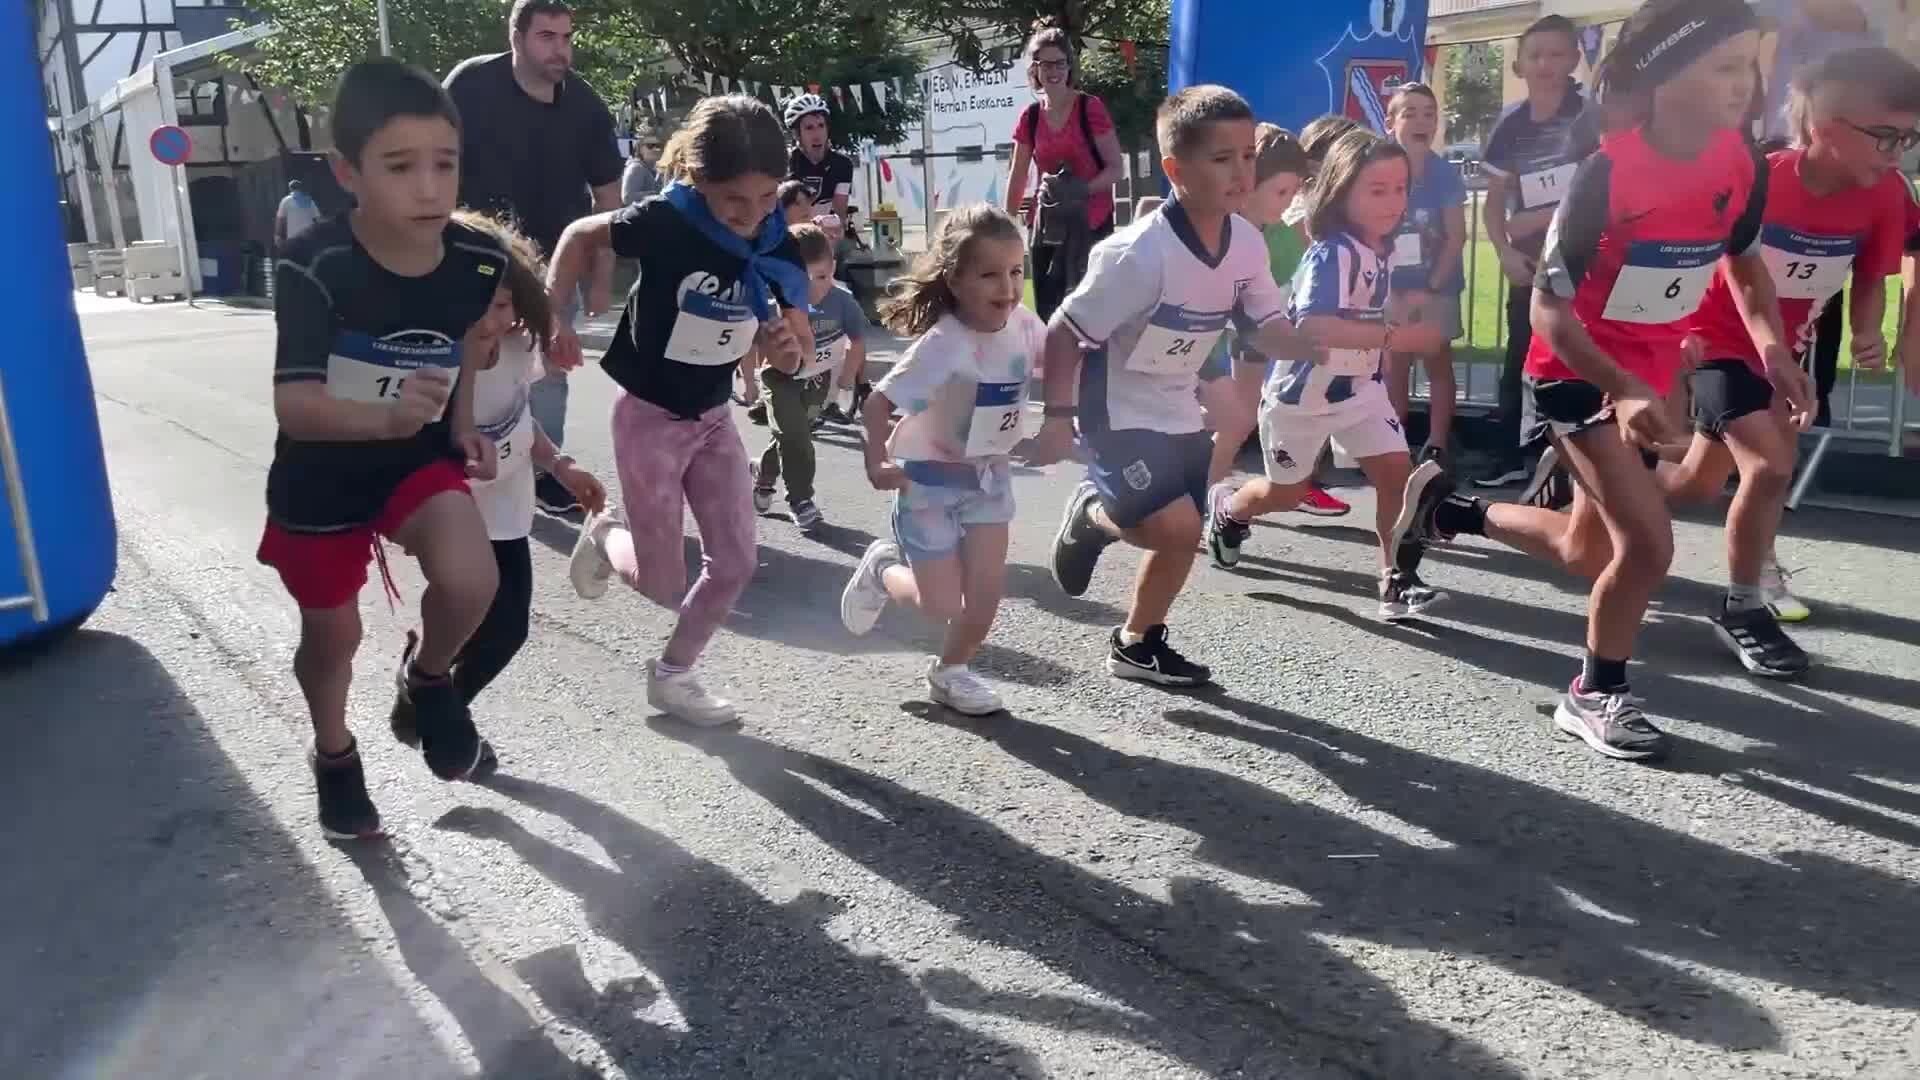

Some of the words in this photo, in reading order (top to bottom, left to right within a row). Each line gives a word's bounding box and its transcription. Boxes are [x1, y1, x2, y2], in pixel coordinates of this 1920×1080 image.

[1786, 262, 1817, 280] 13
[1664, 277, 1682, 299] 6
[717, 328, 734, 346] 5
[1166, 338, 1196, 356] 24
[999, 410, 1020, 431] 23
